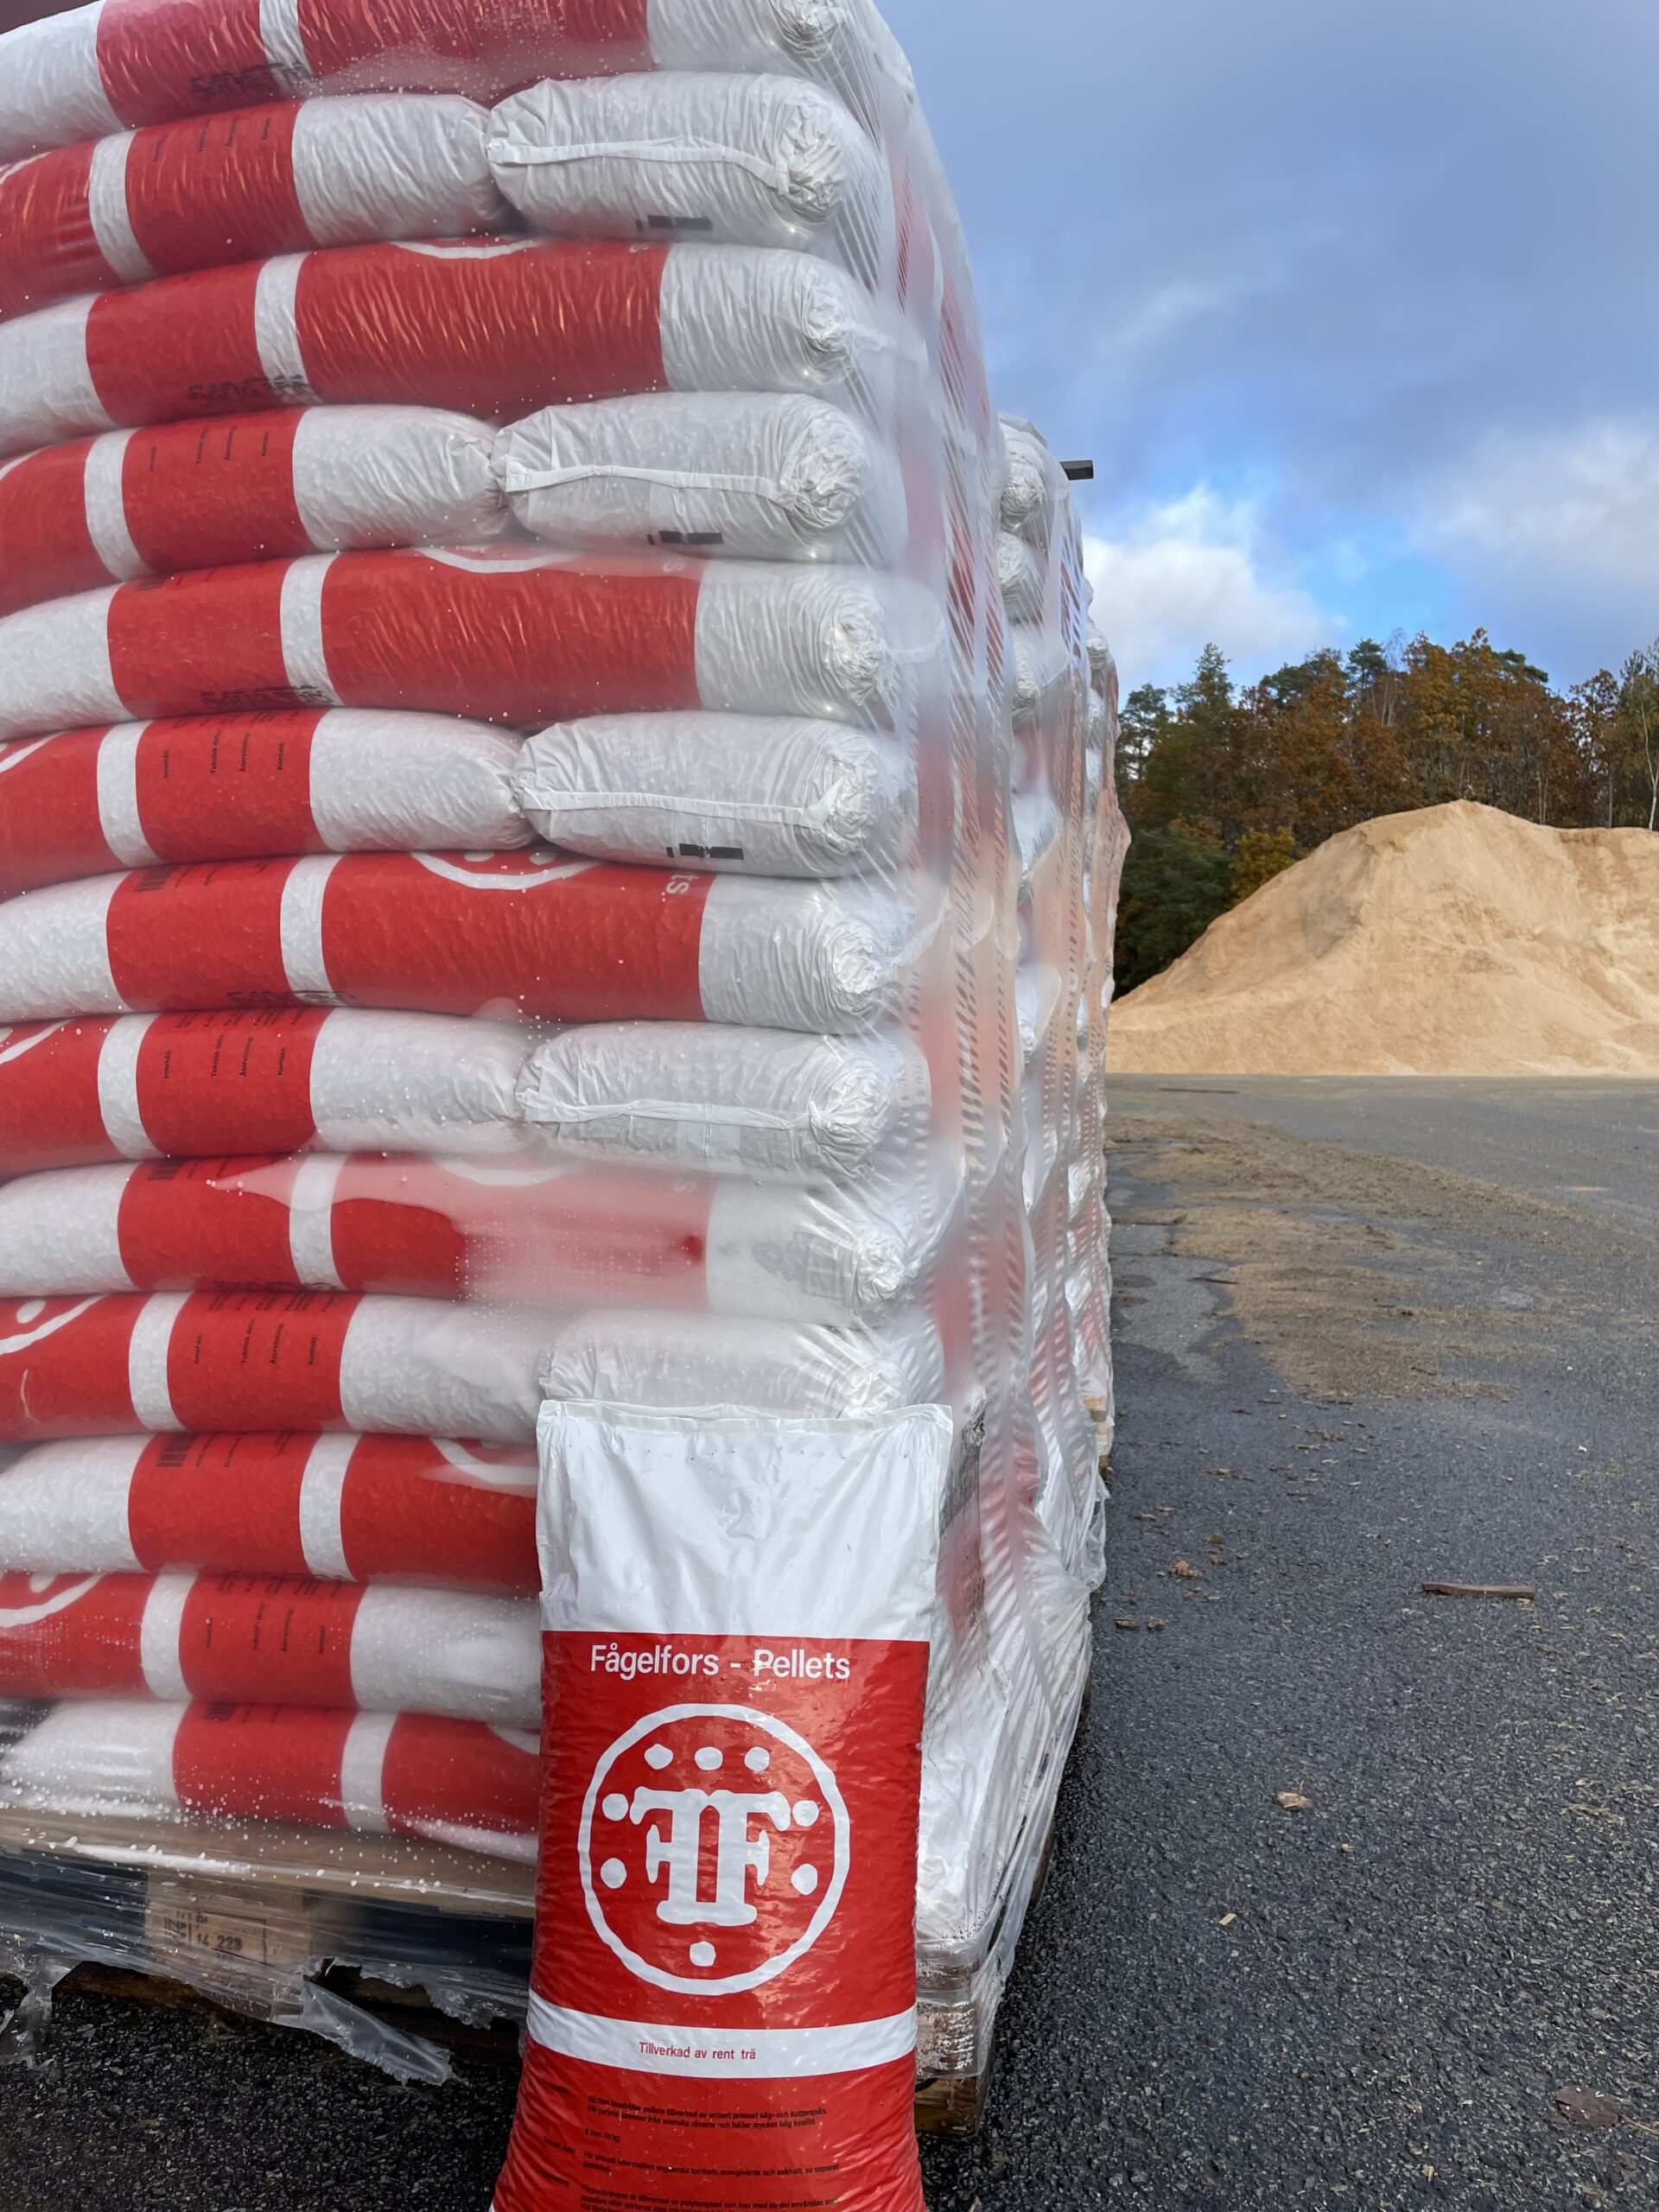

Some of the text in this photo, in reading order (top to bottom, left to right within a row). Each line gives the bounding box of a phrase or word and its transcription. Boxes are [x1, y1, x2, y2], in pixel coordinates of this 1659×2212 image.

[590, 1643, 719, 1681] Fågelfors
[753, 1649, 850, 1680] Pellets
[639, 2041, 756, 2060] Tillverkad av rent trä
